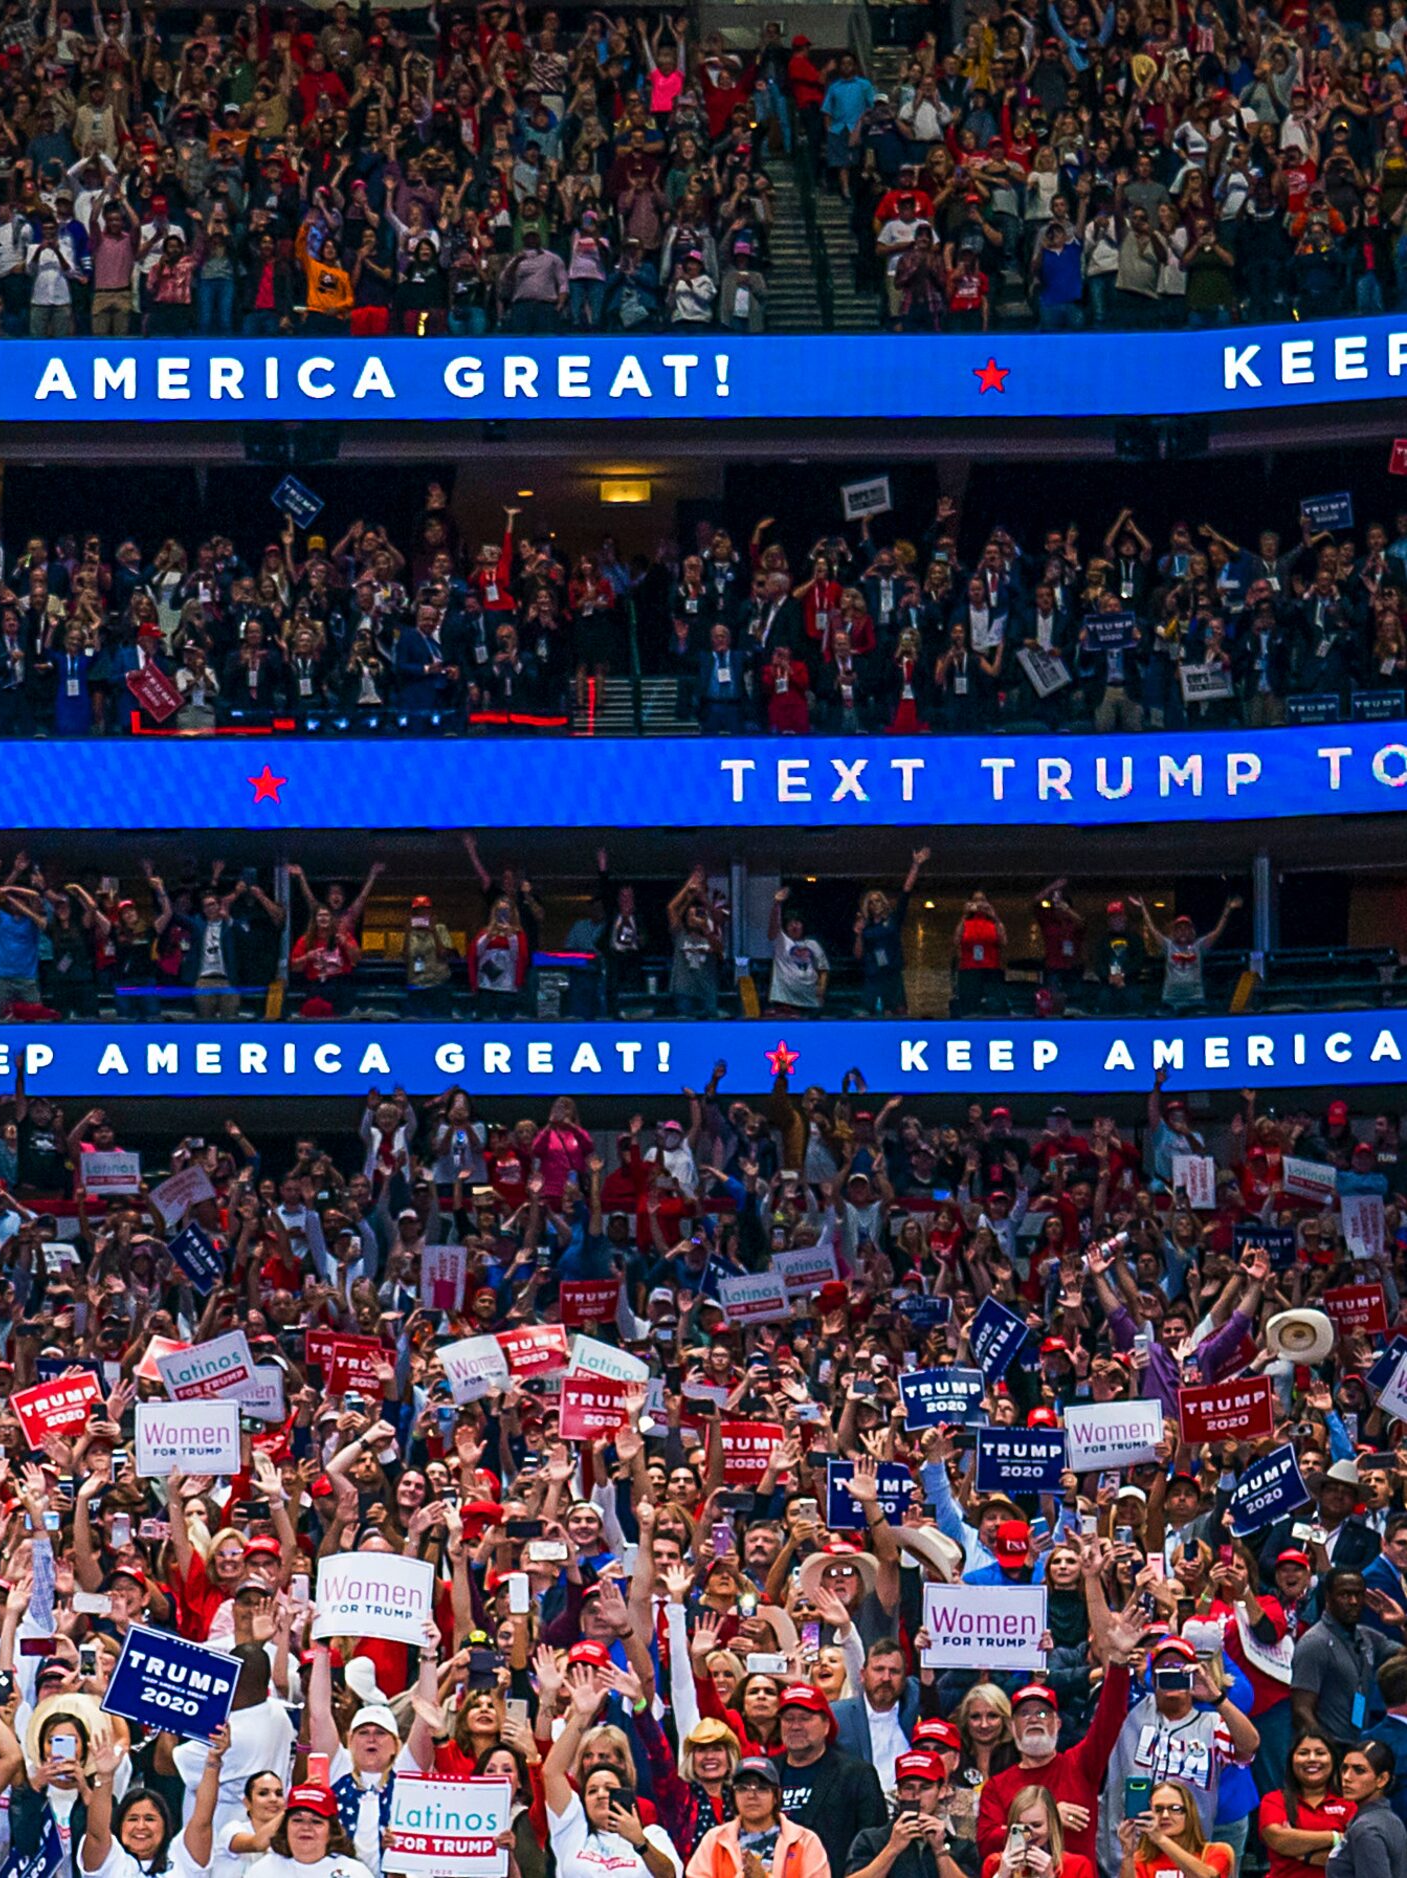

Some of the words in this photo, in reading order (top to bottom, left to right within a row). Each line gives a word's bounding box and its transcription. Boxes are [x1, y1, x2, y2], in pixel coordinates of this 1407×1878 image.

[34, 355, 396, 401] AMERICA
[444, 354, 731, 400] GREAT!
[1088, 619, 1133, 634] TRUMP
[720, 757, 926, 803] TEXT
[981, 751, 1263, 802] TRUMP
[1317, 743, 1407, 790] TO
[96, 1040, 390, 1075] AMERICA
[434, 1039, 673, 1074] GREAT!
[900, 1039, 1059, 1072] KEEP
[1103, 1029, 1401, 1071] AMERICA
[564, 1289, 617, 1302] TRUMP
[1327, 1296, 1381, 1312] TRUMP
[506, 1333, 563, 1353] RUMP
[982, 1320, 1017, 1373] TRUM
[166, 1350, 242, 1386] Latinos
[335, 1356, 372, 1371] TRU
[512, 1350, 550, 1368] 2020
[202, 1369, 246, 1395] TRUMP
[904, 1381, 981, 1399] TRUMP
[19, 1385, 98, 1418] TRUMP
[566, 1391, 626, 1408] TRUM
[925, 1400, 968, 1413] 2020
[1184, 1390, 1267, 1416] TRUMP
[45, 1407, 86, 1428] 2020
[582, 1413, 622, 1427] 2020
[1206, 1414, 1250, 1432] 2020
[143, 1422, 231, 1446] Women
[1072, 1421, 1155, 1446] Women
[152, 1447, 177, 1457] FOR
[180, 1447, 223, 1456] TRUMP
[982, 1443, 1063, 1458] TRUMP
[1083, 1444, 1107, 1455] FOR
[1110, 1441, 1150, 1453] TRUMP
[724, 1458, 768, 1469] 2020
[999, 1465, 1045, 1478] 2020
[1245, 1486, 1284, 1516] 2020
[324, 1575, 423, 1611] Women
[331, 1603, 359, 1615] FOR
[365, 1604, 414, 1620] TRUMP
[931, 1605, 1036, 1636] Women
[942, 1636, 971, 1646] FOR
[976, 1637, 1027, 1648] TRUMP
[128, 1649, 230, 1696] TRUMP
[140, 1686, 199, 1717] 2020
[394, 1798, 498, 1832] Latinos
[393, 1835, 428, 1852] FOR
[431, 1837, 494, 1854] TRUMP
